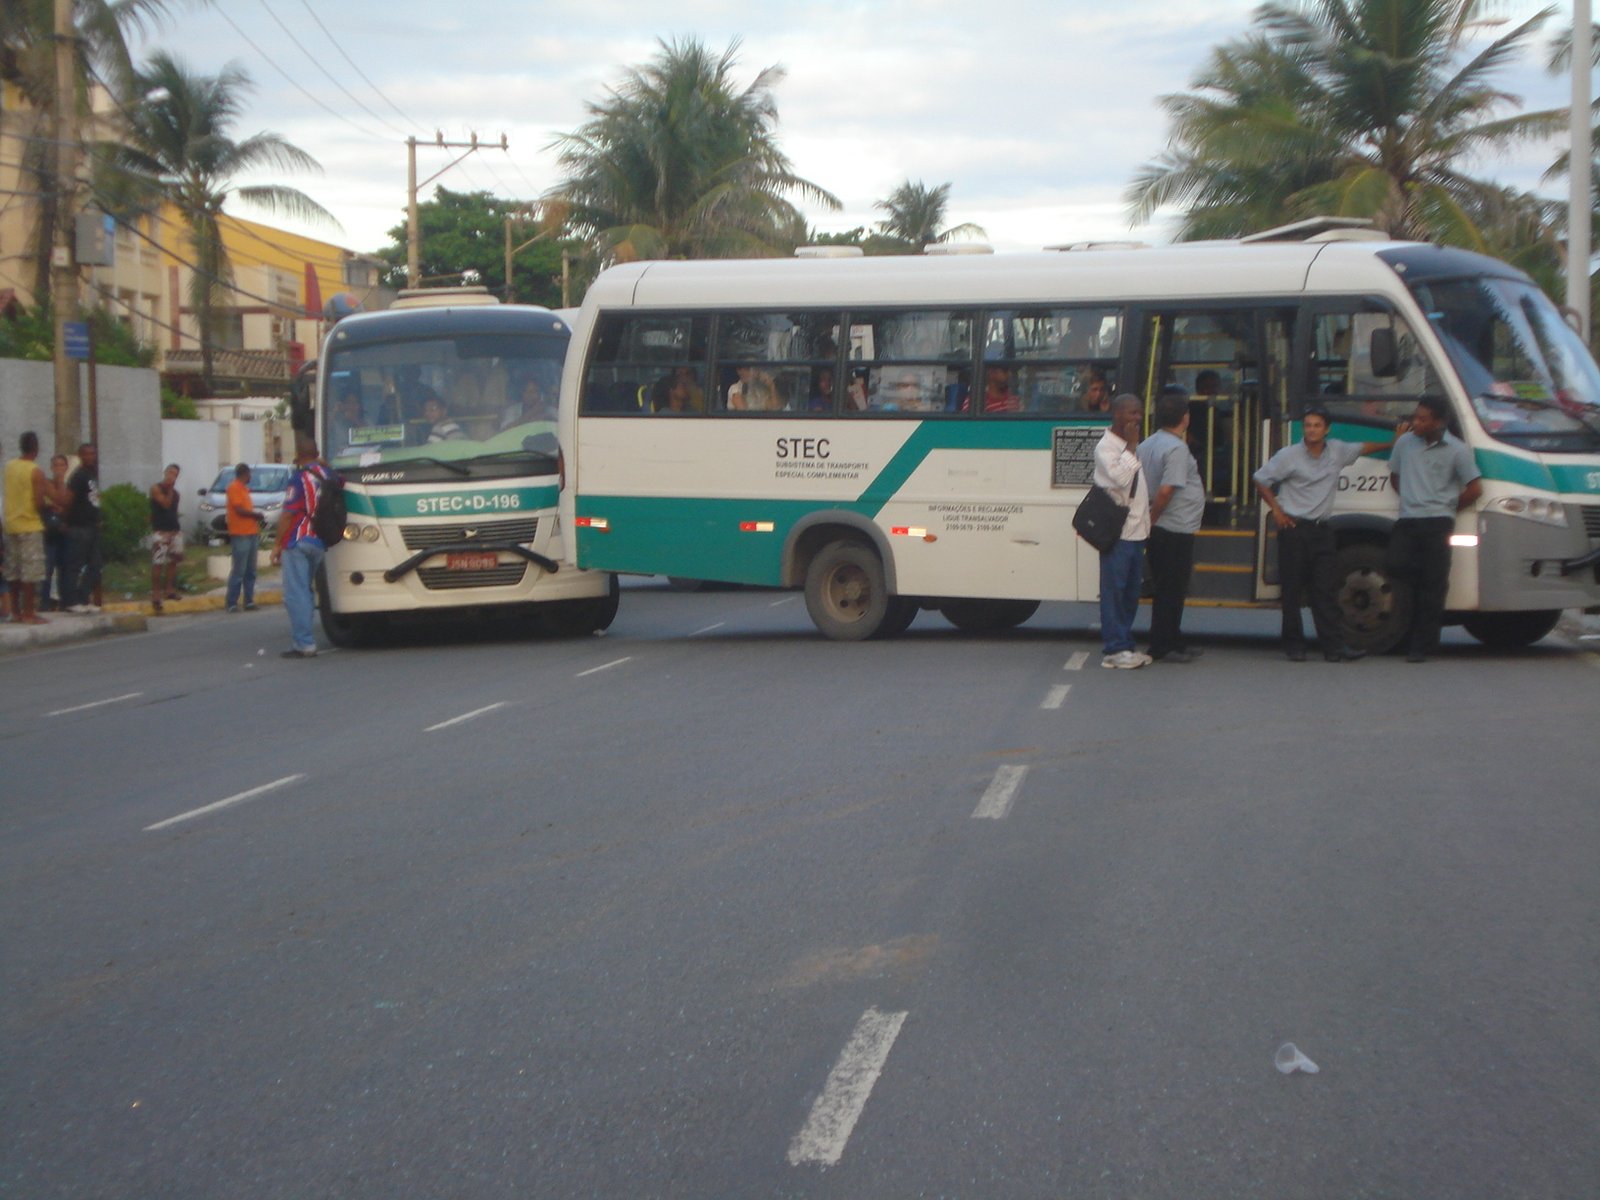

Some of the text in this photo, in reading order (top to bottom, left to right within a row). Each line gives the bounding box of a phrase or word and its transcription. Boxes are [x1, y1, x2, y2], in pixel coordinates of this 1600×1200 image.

[776, 438, 830, 458] STEC
[775, 461, 815, 469] SUBSISTEMA
[827, 462, 869, 470] TRANSPORTE
[806, 471, 859, 479] COMPLEMENTAR
[1337, 475, 1389, 491] D-227
[942, 514, 1008, 522] LIGUE TRANSALVADOR
